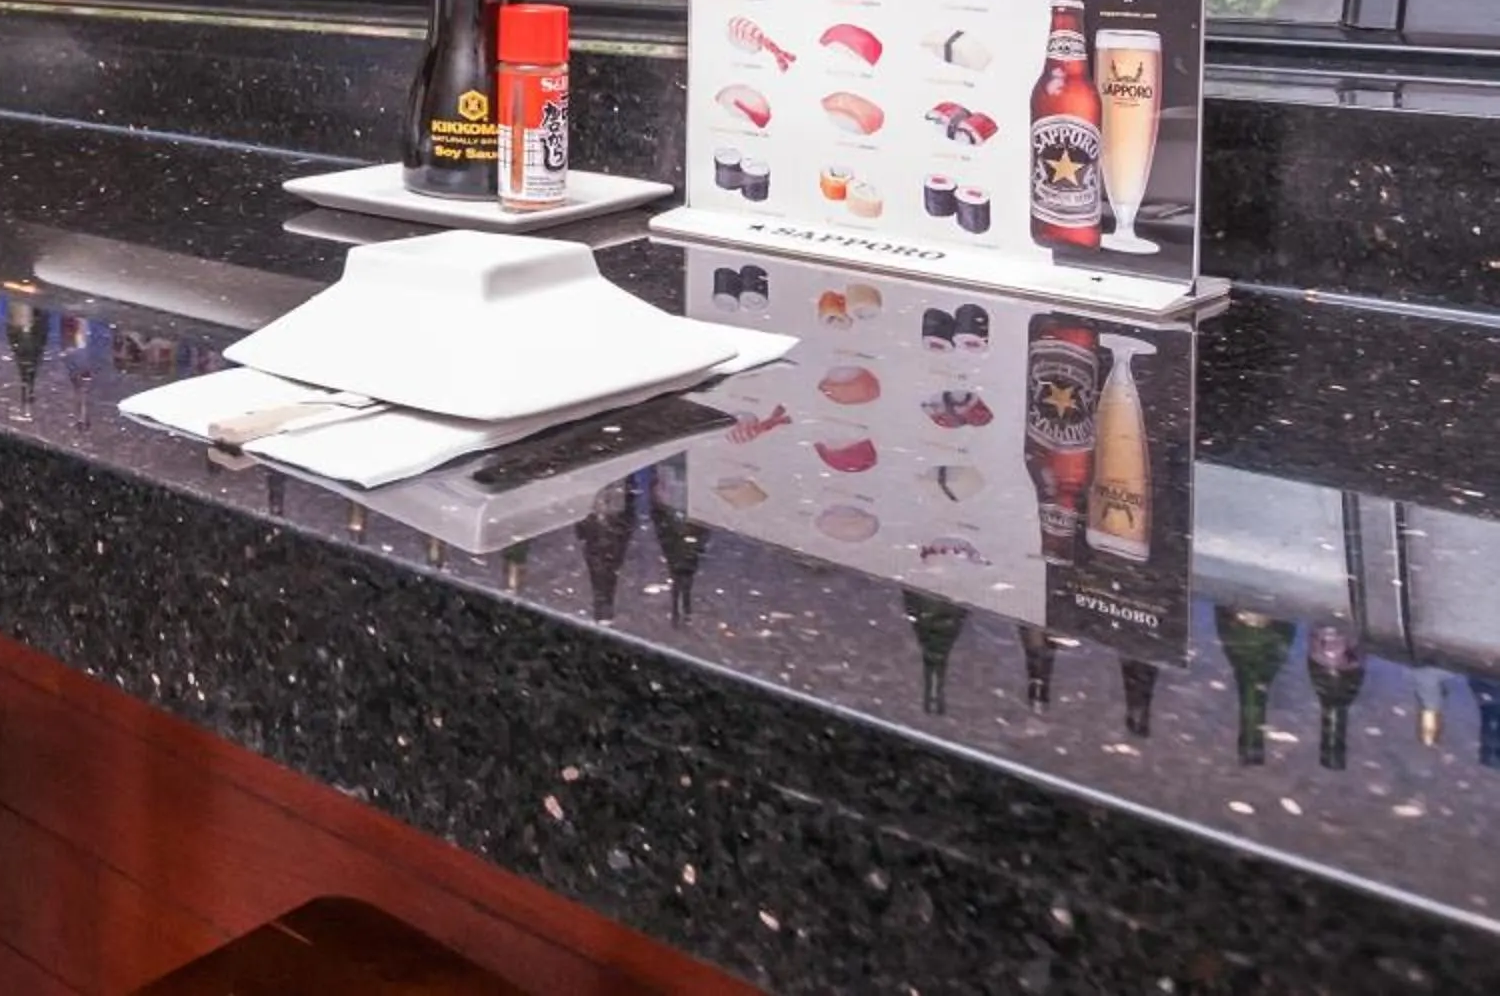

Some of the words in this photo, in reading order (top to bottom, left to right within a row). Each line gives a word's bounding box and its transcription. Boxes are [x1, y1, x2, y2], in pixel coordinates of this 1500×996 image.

[1102, 82, 1153, 99] SAPPORO
[434, 145, 461, 160] Soy
[465, 148, 498, 159] Sau
[1033, 125, 1100, 160] SAPPORO
[770, 226, 947, 262] SAPPORO
